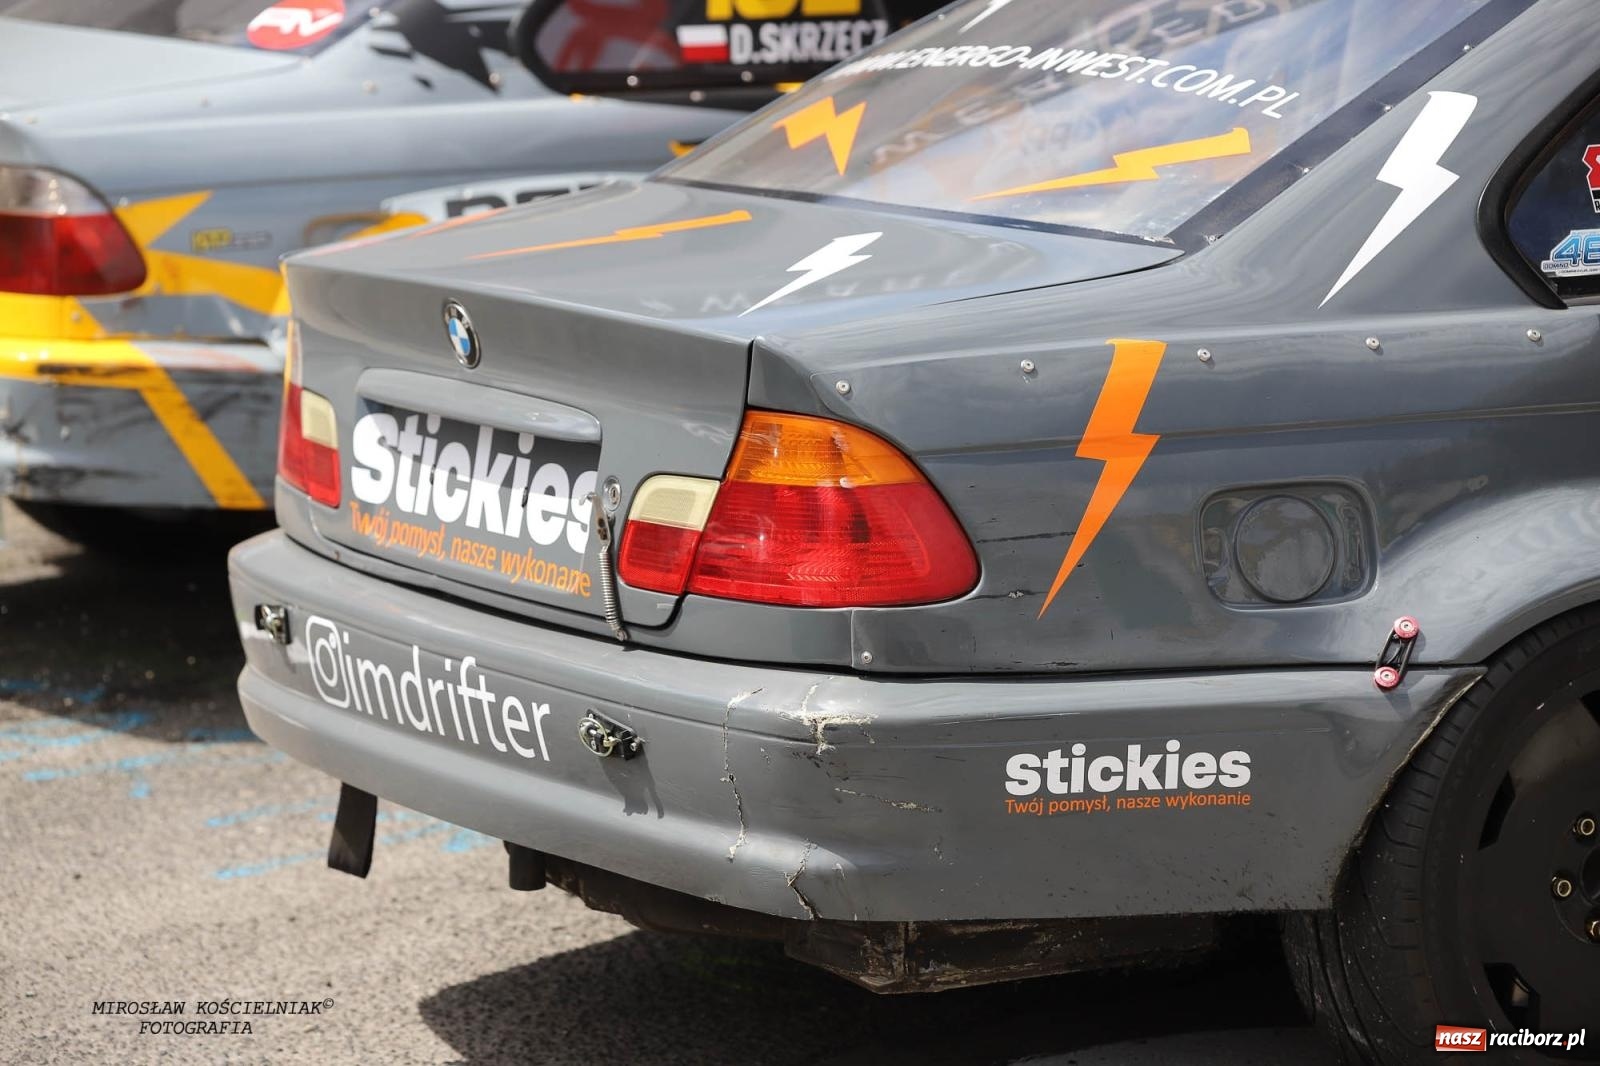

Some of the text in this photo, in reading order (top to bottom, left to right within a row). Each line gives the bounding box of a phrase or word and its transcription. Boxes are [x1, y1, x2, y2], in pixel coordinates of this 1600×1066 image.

[450, 536, 497, 571] nasze
[1005, 739, 1251, 796] stickies
[1005, 791, 1252, 816] Twój pomysł, nasze wykonanie
